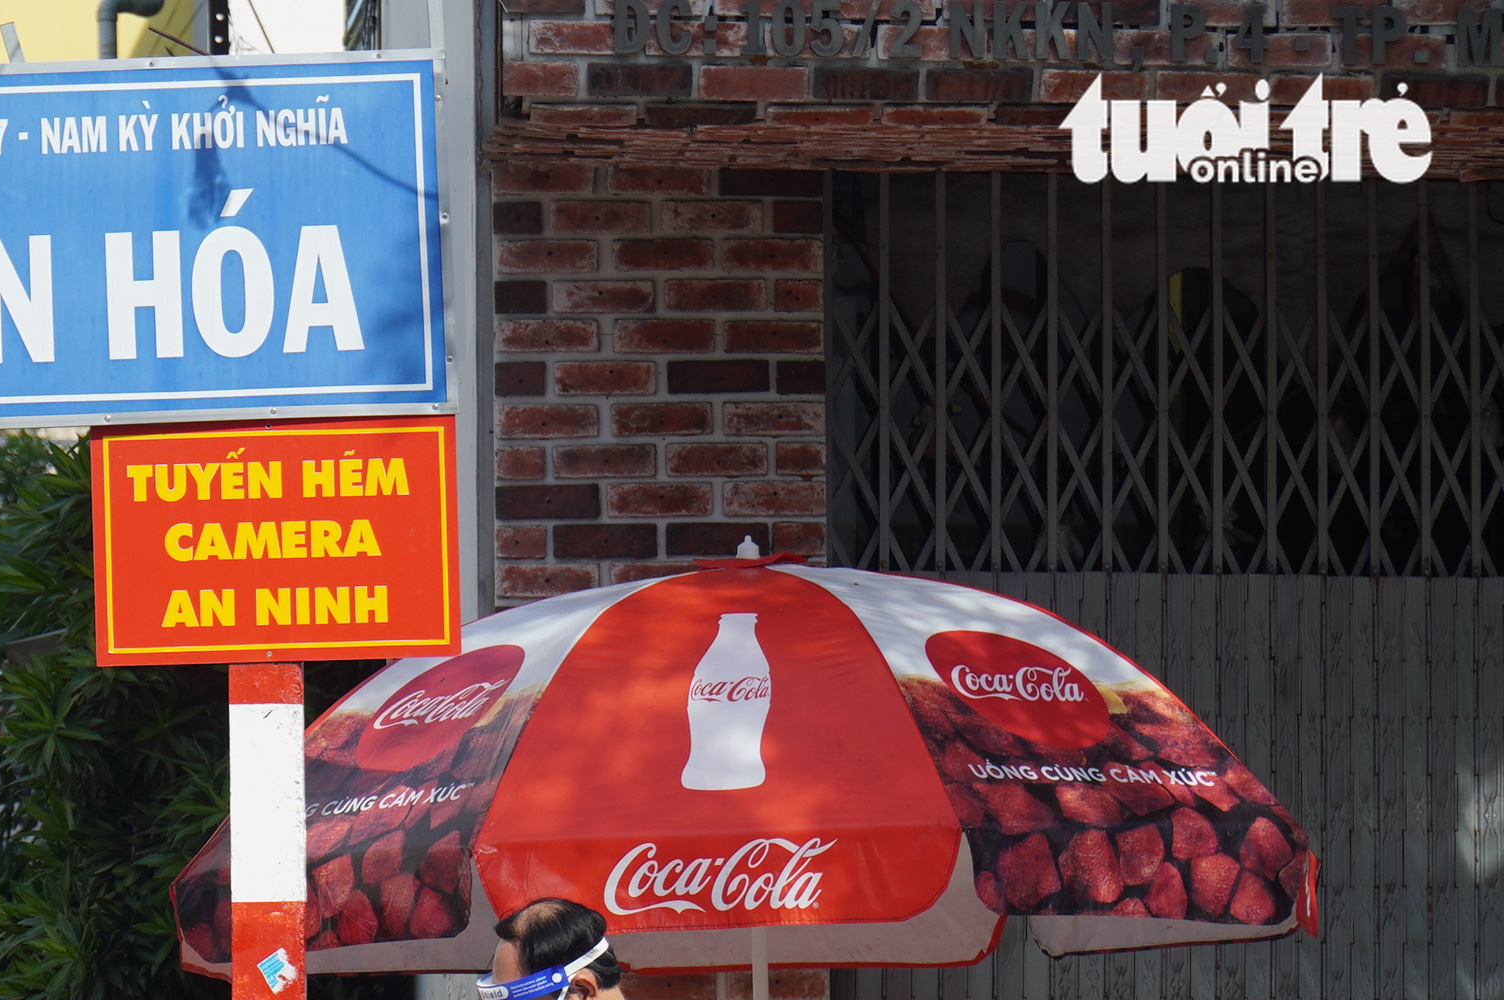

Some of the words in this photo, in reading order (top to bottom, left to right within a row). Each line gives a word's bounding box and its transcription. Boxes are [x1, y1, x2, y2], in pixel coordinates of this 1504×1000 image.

[41, 116, 107, 155] NAM
[119, 100, 158, 152] KỲ
[171, 94, 244, 150] KHỞI
[256, 94, 348, 148] NGHĨA
[105, 188, 365, 360] HÓA
[127, 447, 283, 502] TUYẾN
[164, 519, 382, 562] CAMERA
[161, 588, 235, 627] AN
[255, 585, 388, 626] NINH
[373, 678, 511, 729] Coca-Cola
[691, 676, 770, 702] Coca-Cola
[951, 664, 1085, 702] Coca-Cola
[1041, 764, 1107, 783] CÙNG
[604, 837, 838, 915] Coca-Cola
